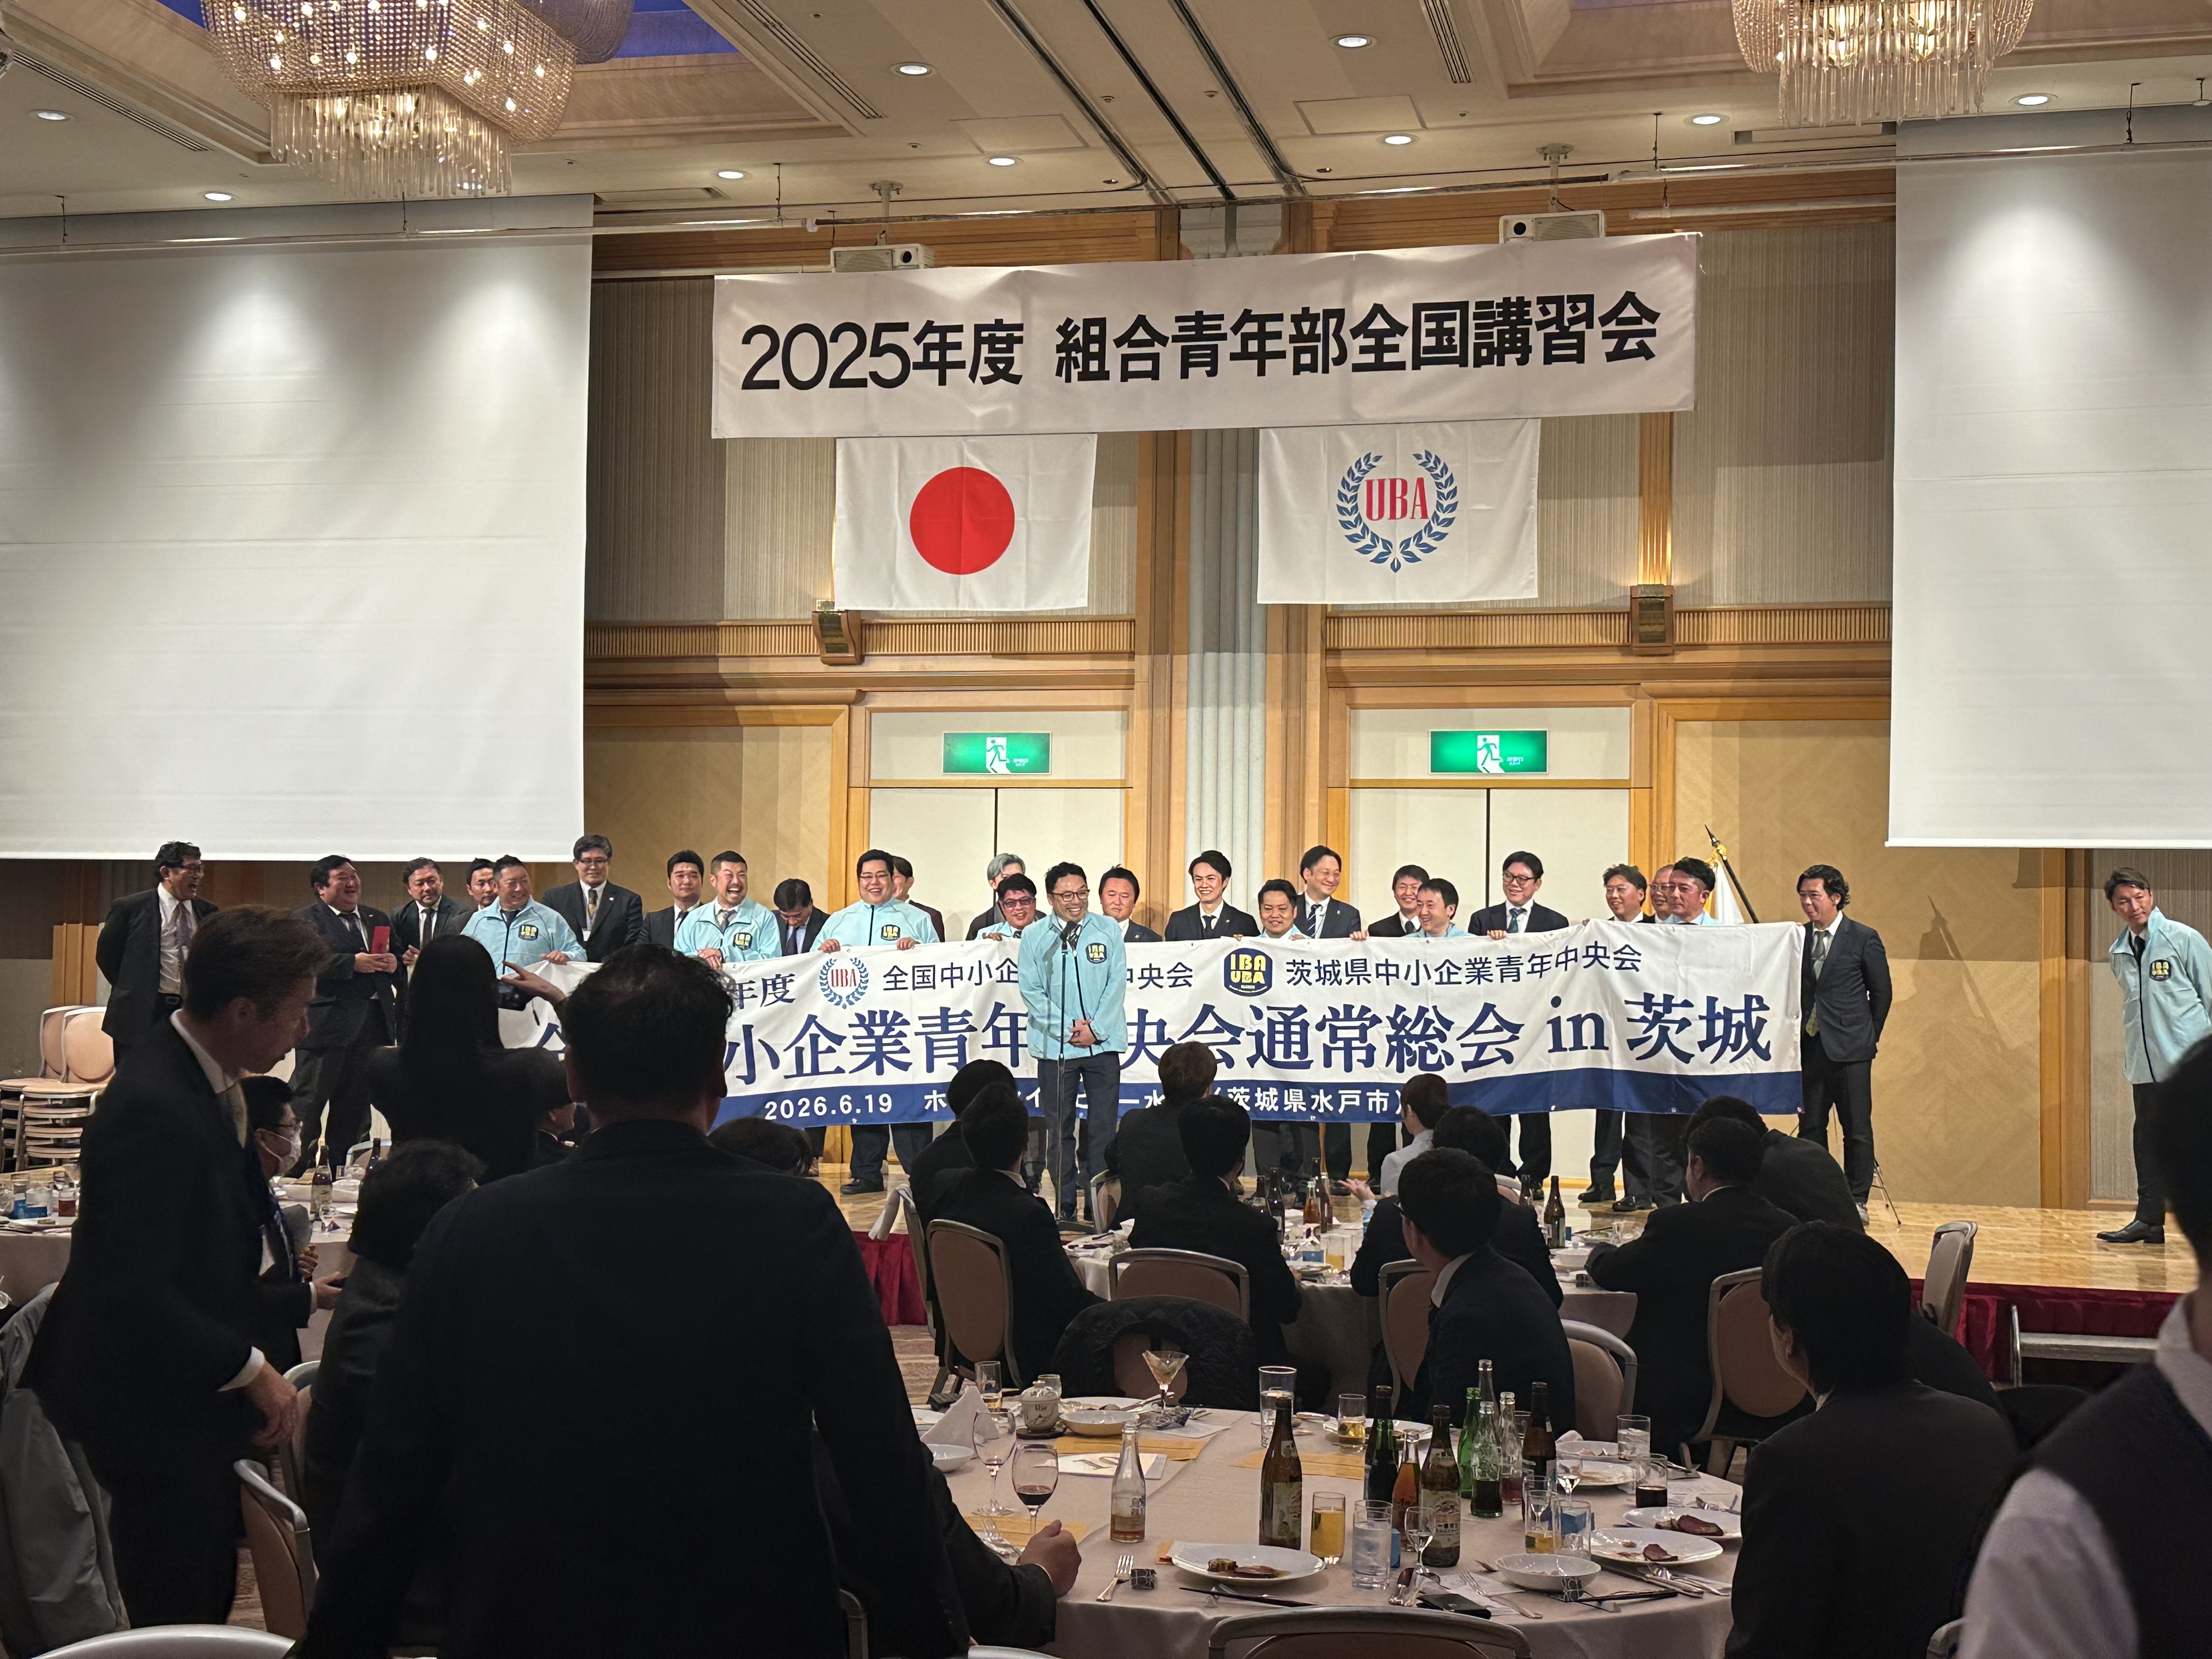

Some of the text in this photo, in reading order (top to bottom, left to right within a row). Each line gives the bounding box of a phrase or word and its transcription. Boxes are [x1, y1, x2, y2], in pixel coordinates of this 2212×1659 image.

[741, 290, 1661, 391] 2025年度 組合青年部全国講習会
[1365, 477, 1429, 521] UBA
[831, 969, 856, 987] UBA
[1231, 954, 1266, 971] IBA
[1286, 940, 1641, 986] 茨城県中小企業青年中央会
[1547, 996, 1609, 1053] in
[1624, 992, 1771, 1064] 茨城
[765, 1093, 892, 1120] 2026.6.19
